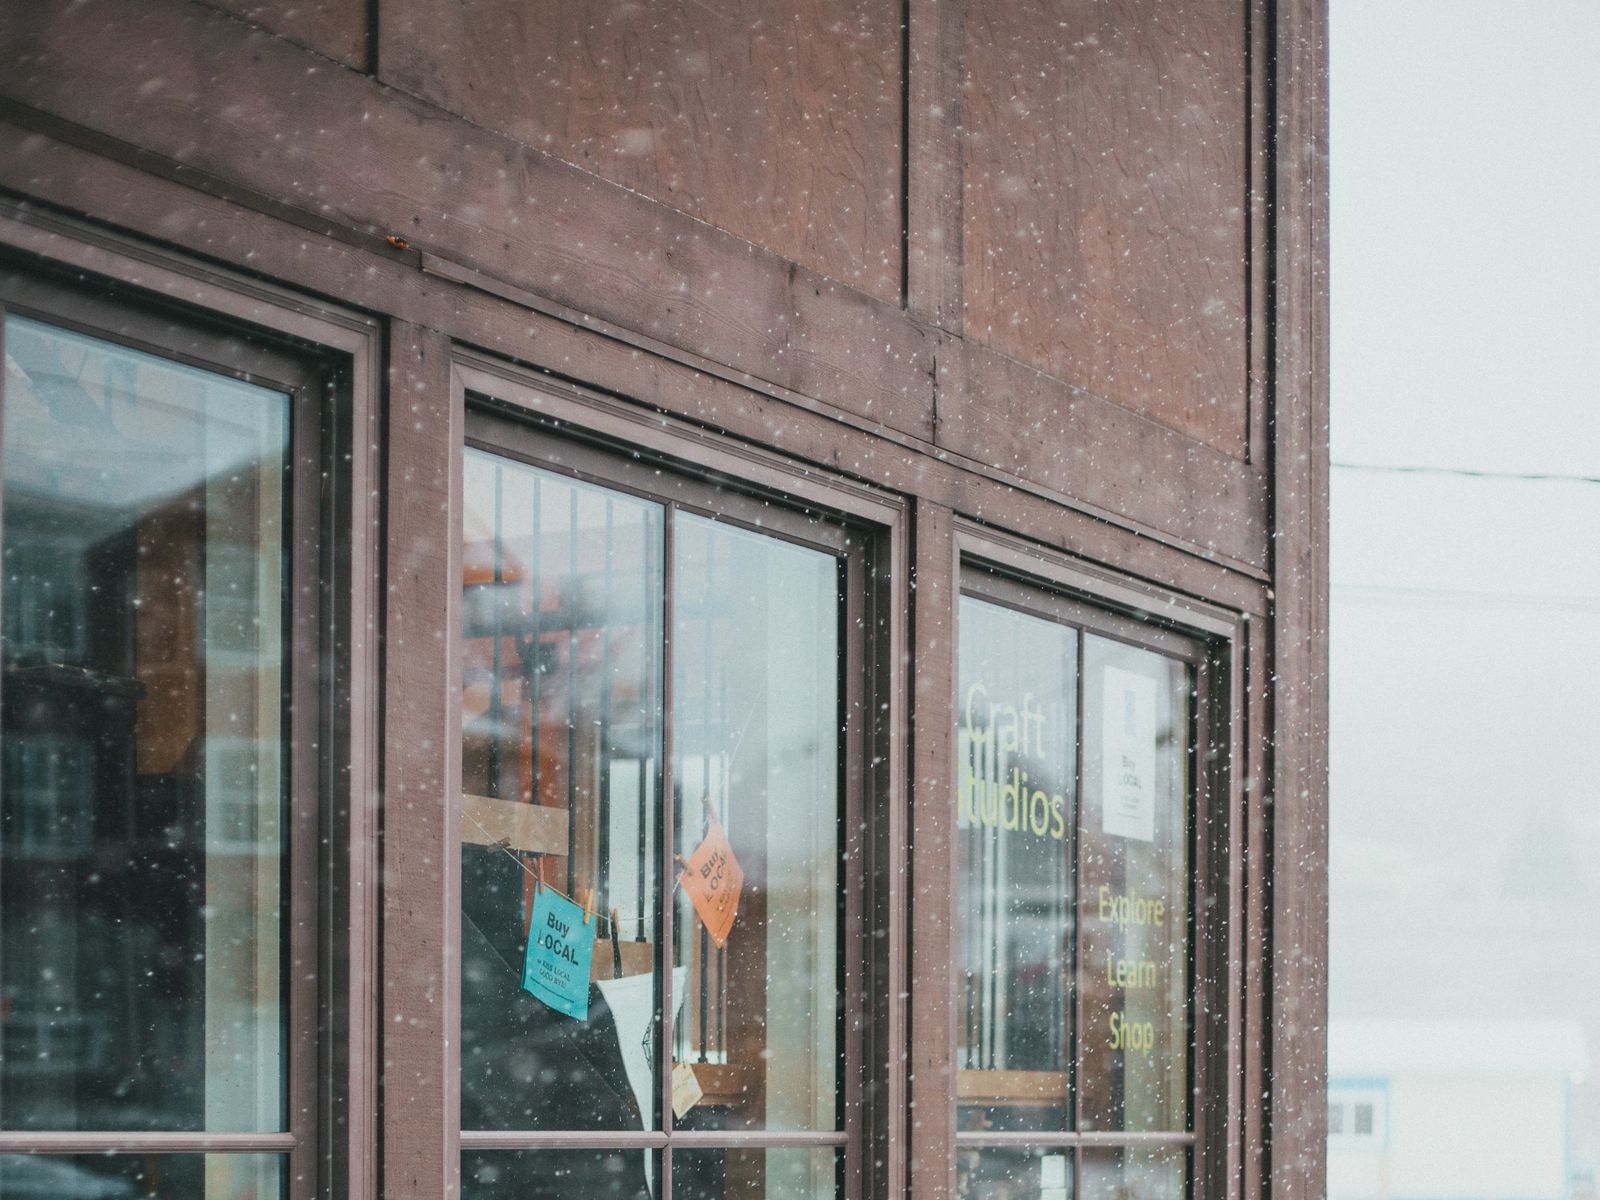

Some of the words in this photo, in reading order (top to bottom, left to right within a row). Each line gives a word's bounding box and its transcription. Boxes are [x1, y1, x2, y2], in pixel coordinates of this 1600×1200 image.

[966, 680, 1046, 760] Craft
[547, 911, 570, 938] Buy
[1098, 884, 1165, 928] Explore
[537, 928, 579, 966] LOCAL
[1107, 948, 1156, 990] Learn
[1109, 1011, 1155, 1058] Shop
